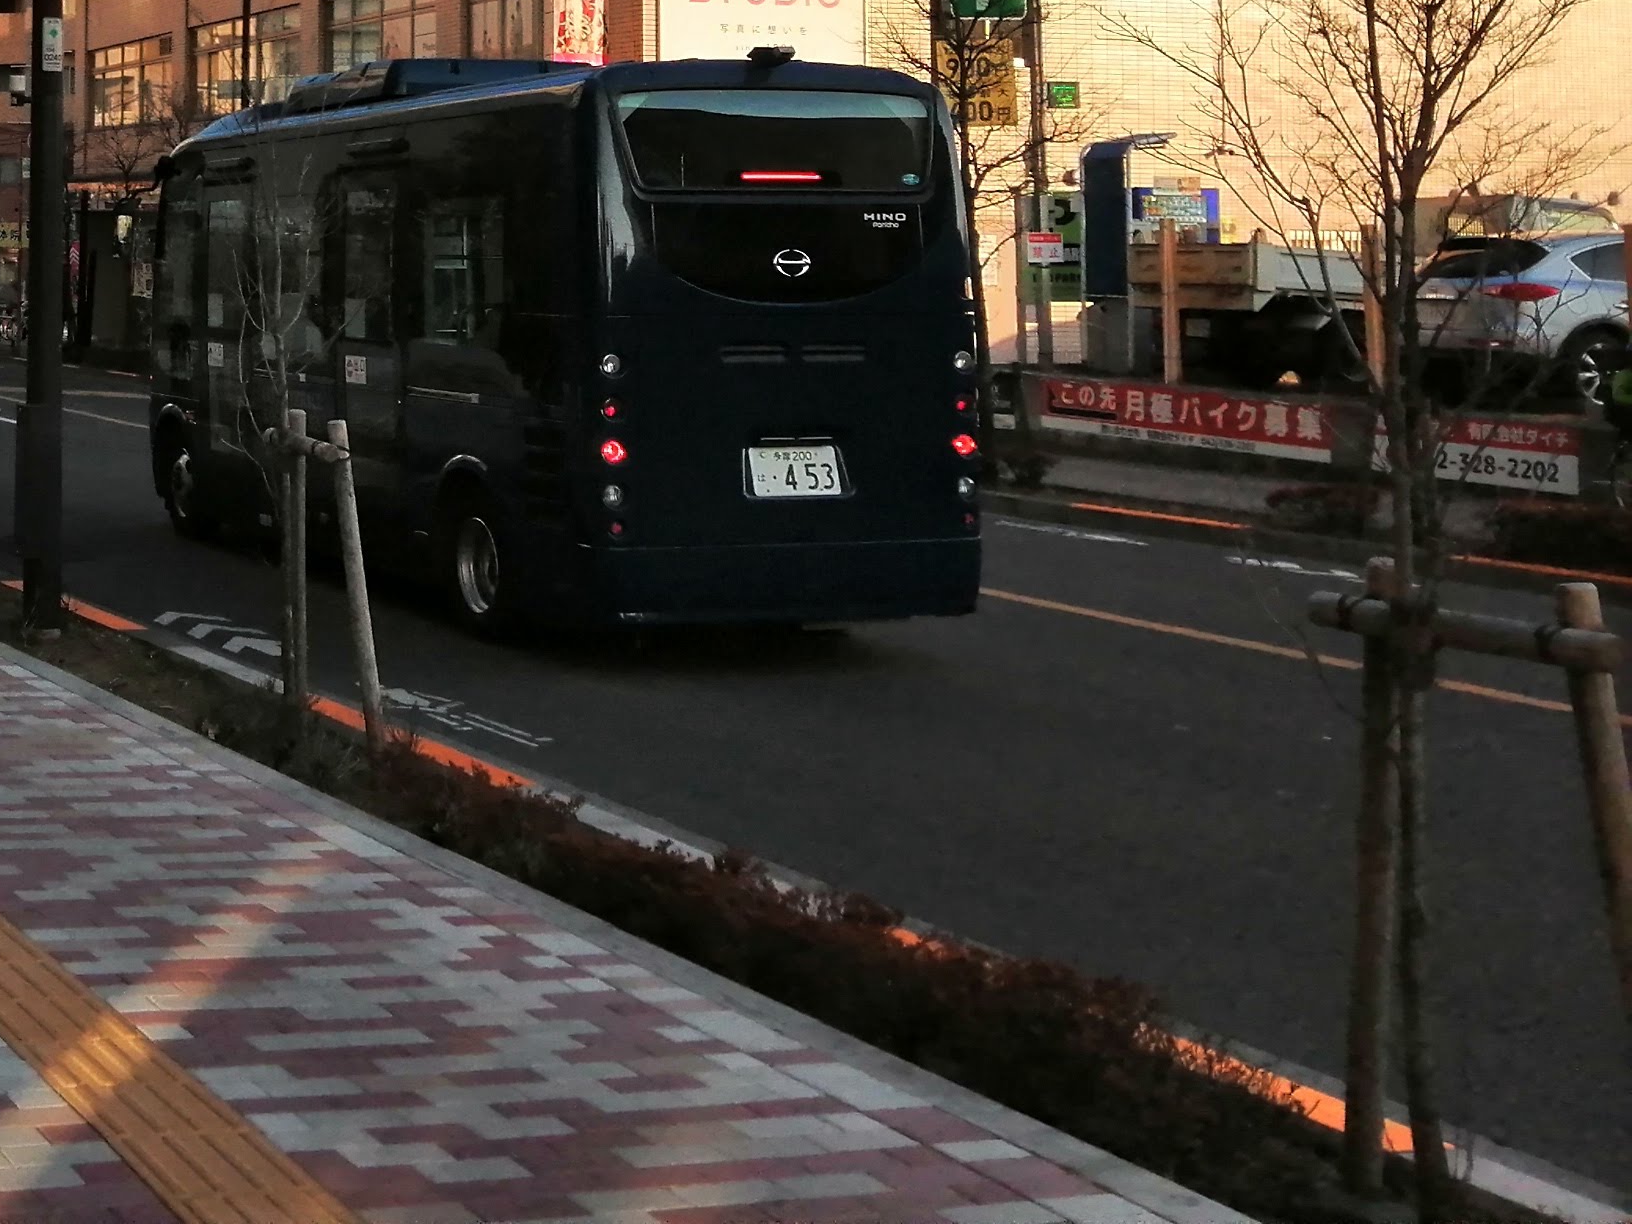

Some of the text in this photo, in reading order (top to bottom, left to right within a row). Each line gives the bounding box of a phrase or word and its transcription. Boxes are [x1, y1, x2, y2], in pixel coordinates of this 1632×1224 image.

[720, 24, 808, 36] 写真に想いを
[863, 213, 907, 222] HINO
[1061, 383, 1117, 410] この先
